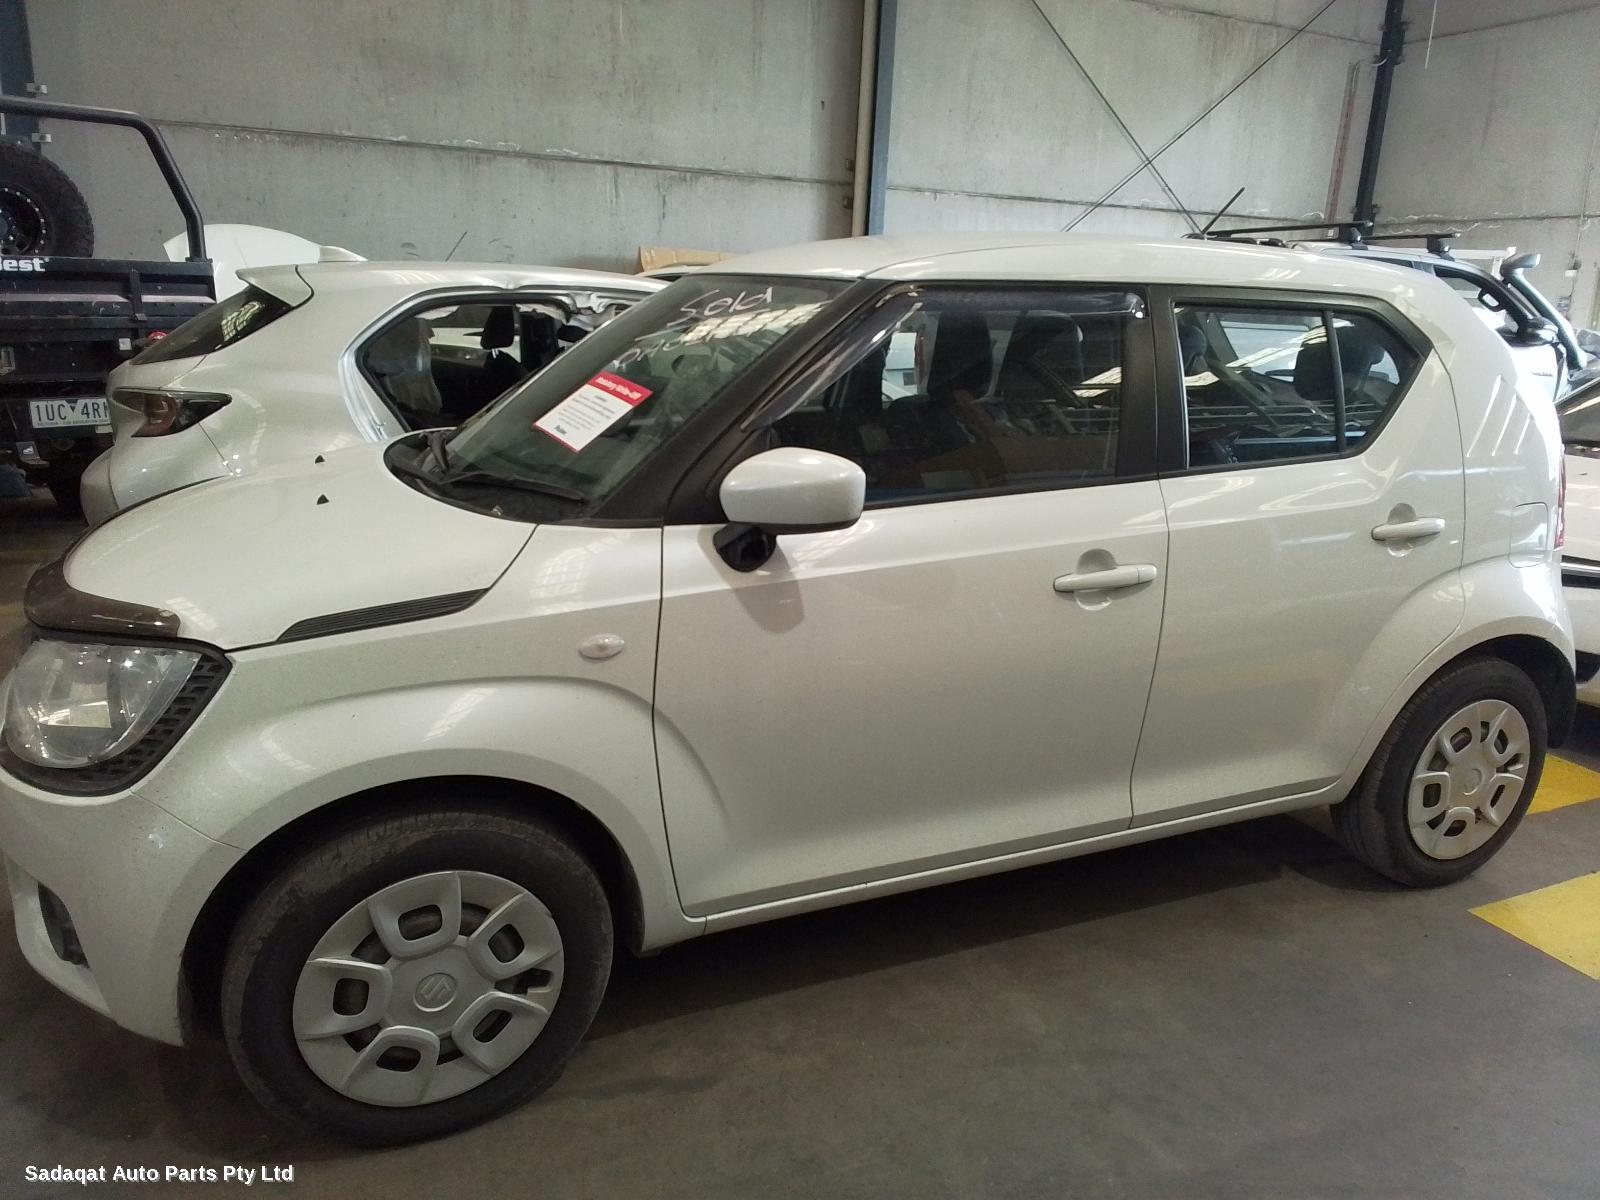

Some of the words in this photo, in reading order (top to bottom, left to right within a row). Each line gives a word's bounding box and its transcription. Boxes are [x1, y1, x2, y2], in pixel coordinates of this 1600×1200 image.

[0, 257, 46, 272] est
[667, 286, 773, 327] Sold
[35, 403, 67, 422] 1UC
